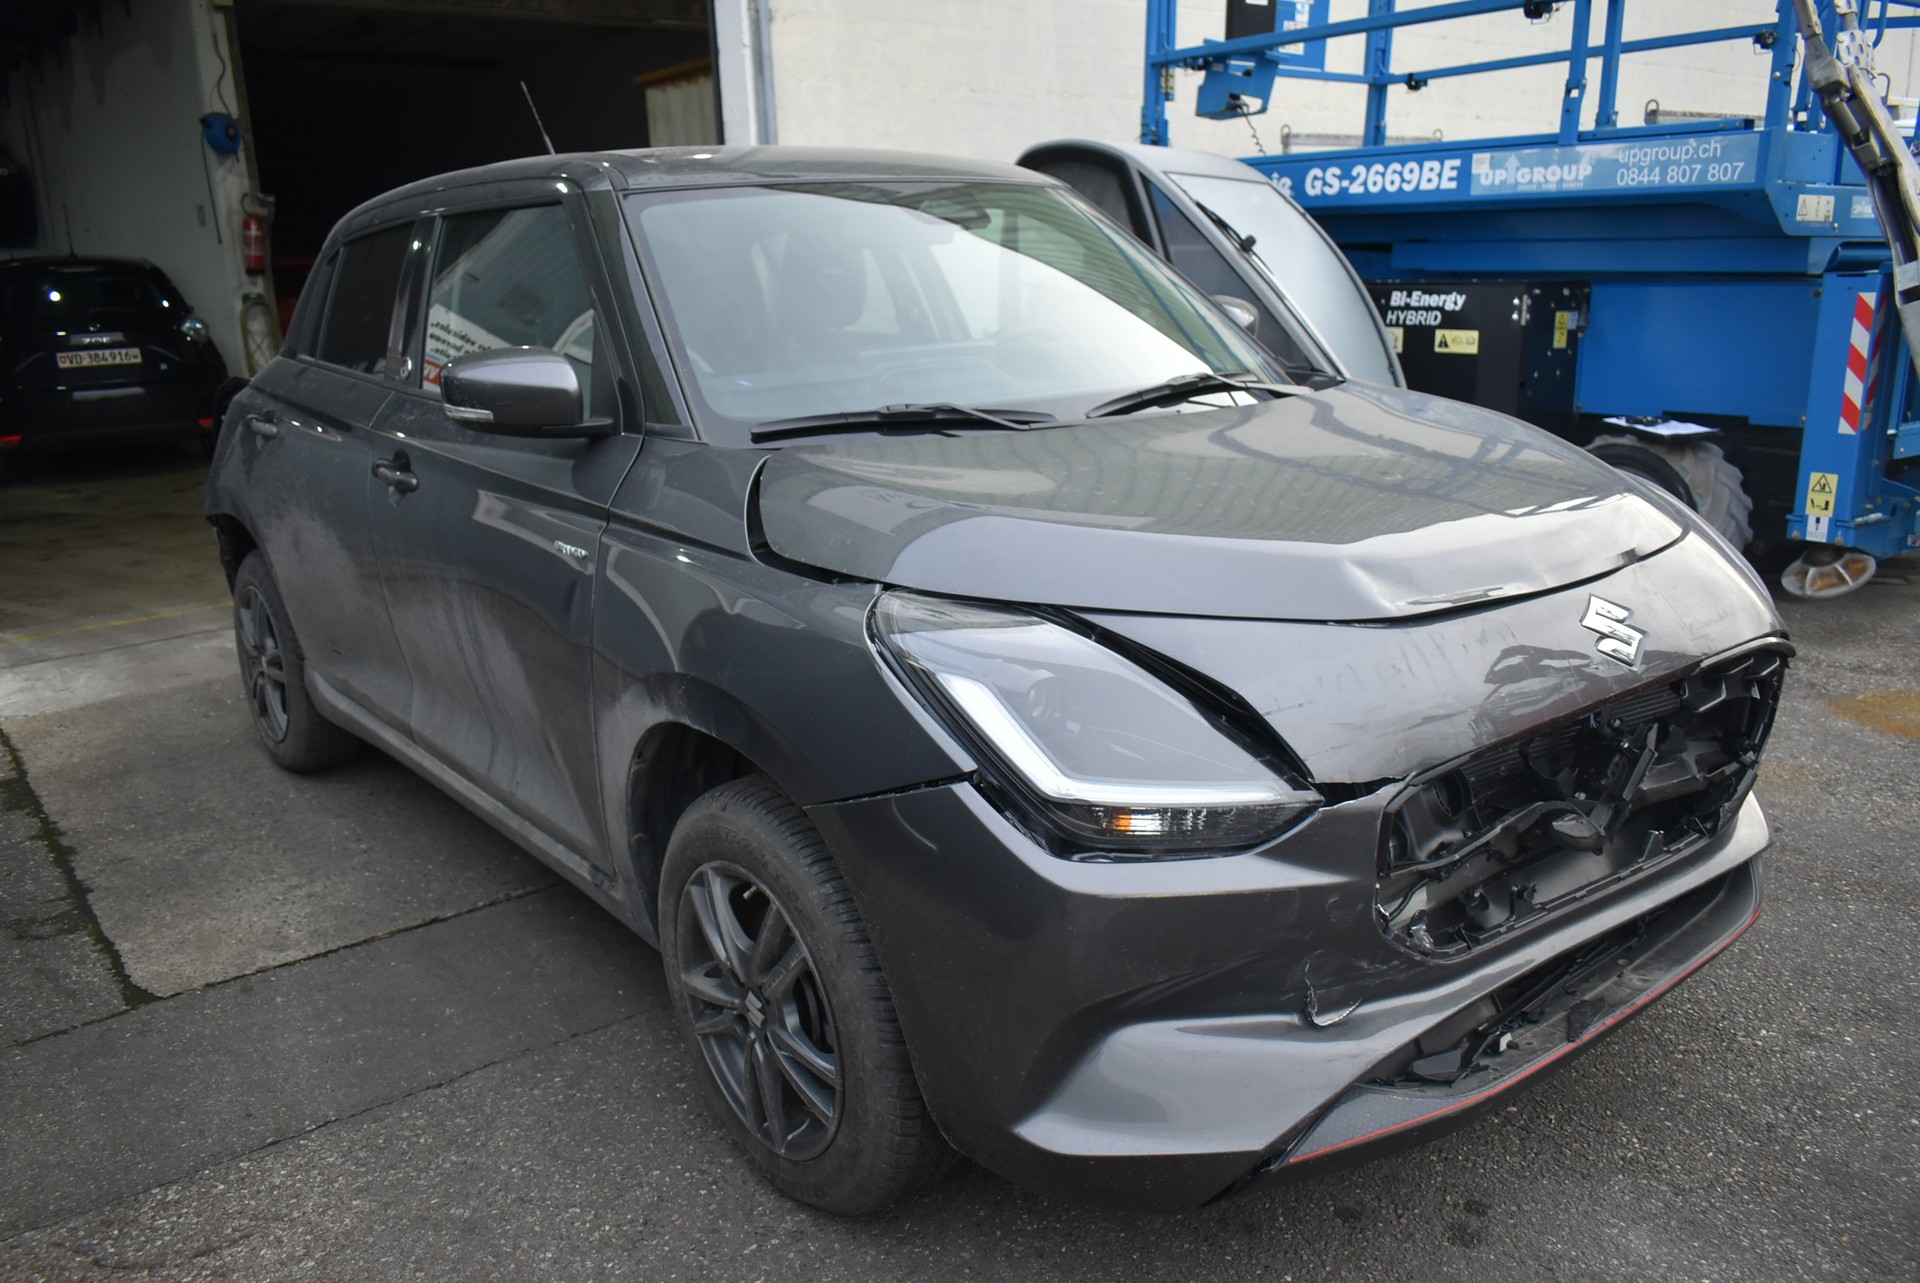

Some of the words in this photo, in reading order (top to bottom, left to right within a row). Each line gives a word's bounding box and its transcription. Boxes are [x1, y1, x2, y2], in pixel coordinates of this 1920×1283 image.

[1618, 140, 1721, 167] upgroup.ch
[1304, 158, 1462, 197] GS-2669BE
[1516, 163, 1593, 184] GROUP
[1616, 166, 1661, 186] 0844
[1666, 164, 1702, 184] 807
[1707, 162, 1745, 182] 807
[1385, 310, 1442, 326] HYBRID
